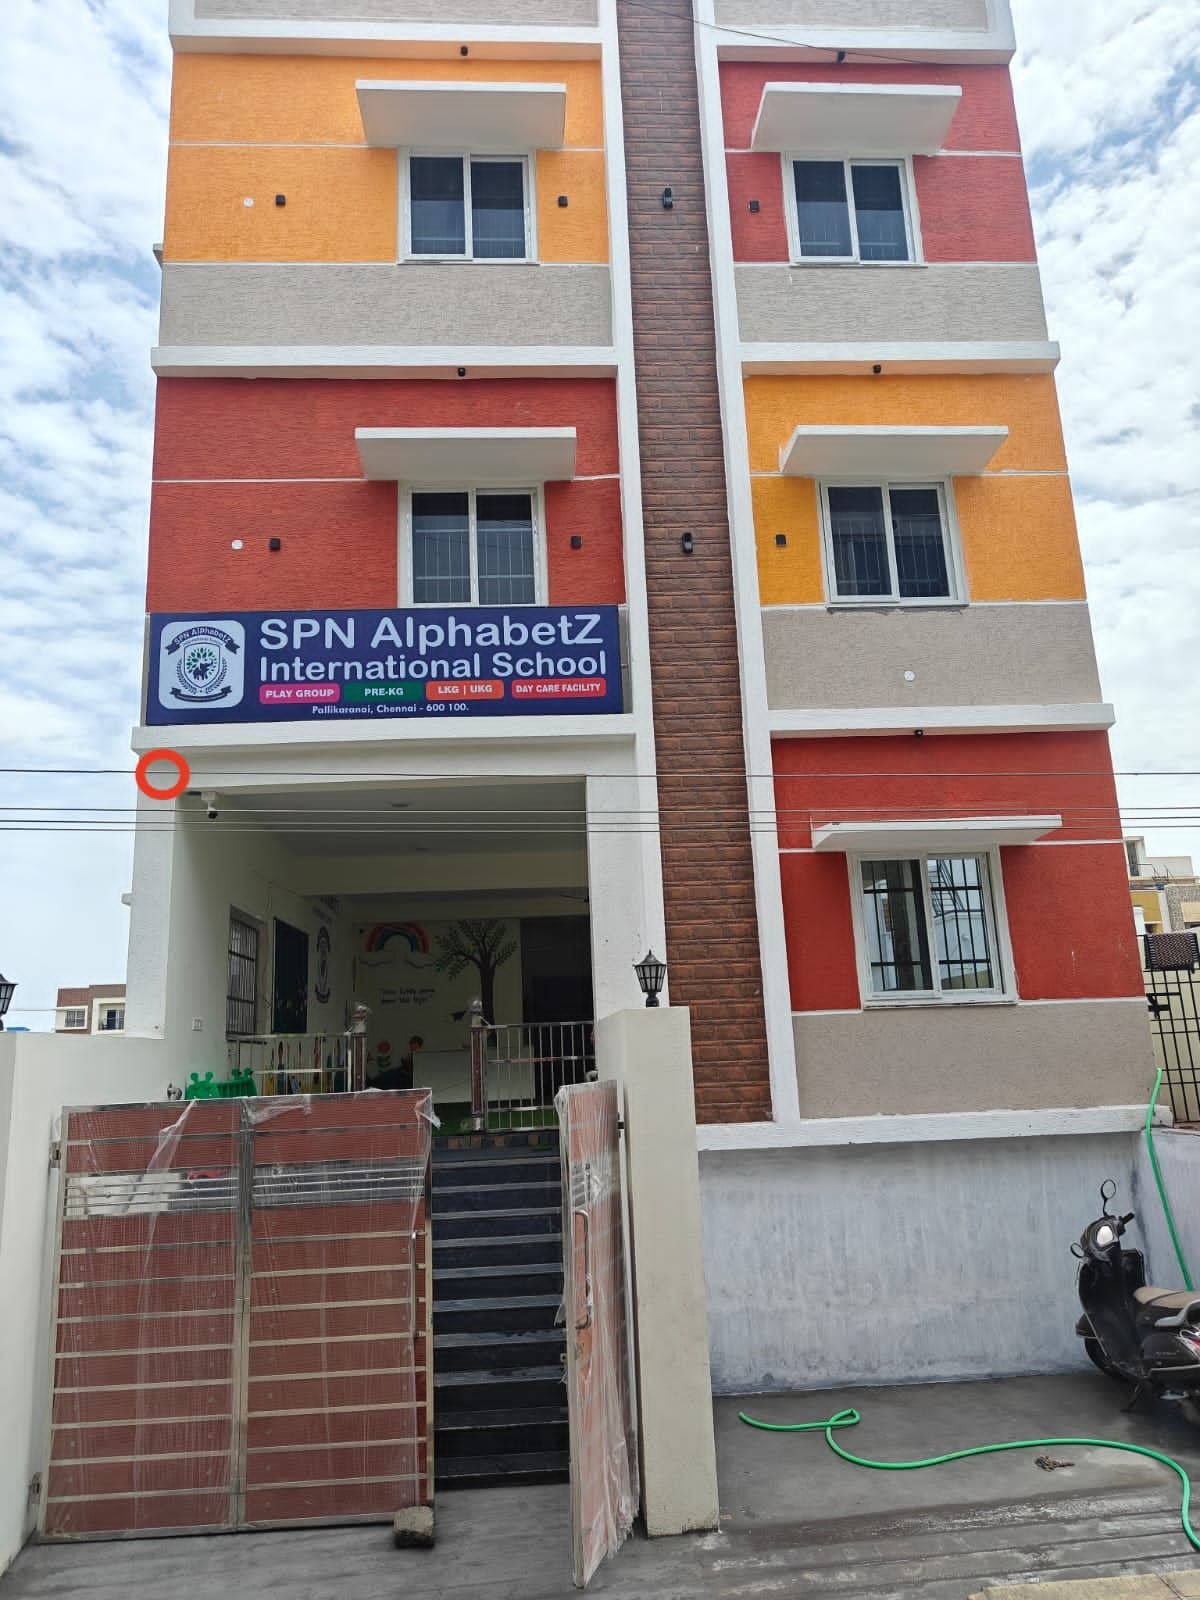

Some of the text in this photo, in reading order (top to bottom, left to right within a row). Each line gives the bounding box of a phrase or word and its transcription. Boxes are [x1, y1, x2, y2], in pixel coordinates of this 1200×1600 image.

[174, 632, 190, 645] SPN
[191, 626, 232, 645] AlphabetZ
[260, 614, 604, 655] SPN AlphabetZ
[260, 650, 606, 682] International School
[265, 688, 335, 698] PLAY GROUP
[364, 687, 404, 697] PRE-KG
[438, 685, 460, 694] LKG
[470, 684, 493, 694] UKG
[515, 682, 601, 693] DAY CARE FACILITY
[312, 705, 374, 715] Pallikaranai,
[376, 704, 417, 714] Chennai
[426, 703, 445, 712] 600
[449, 702, 469, 712] 100.
